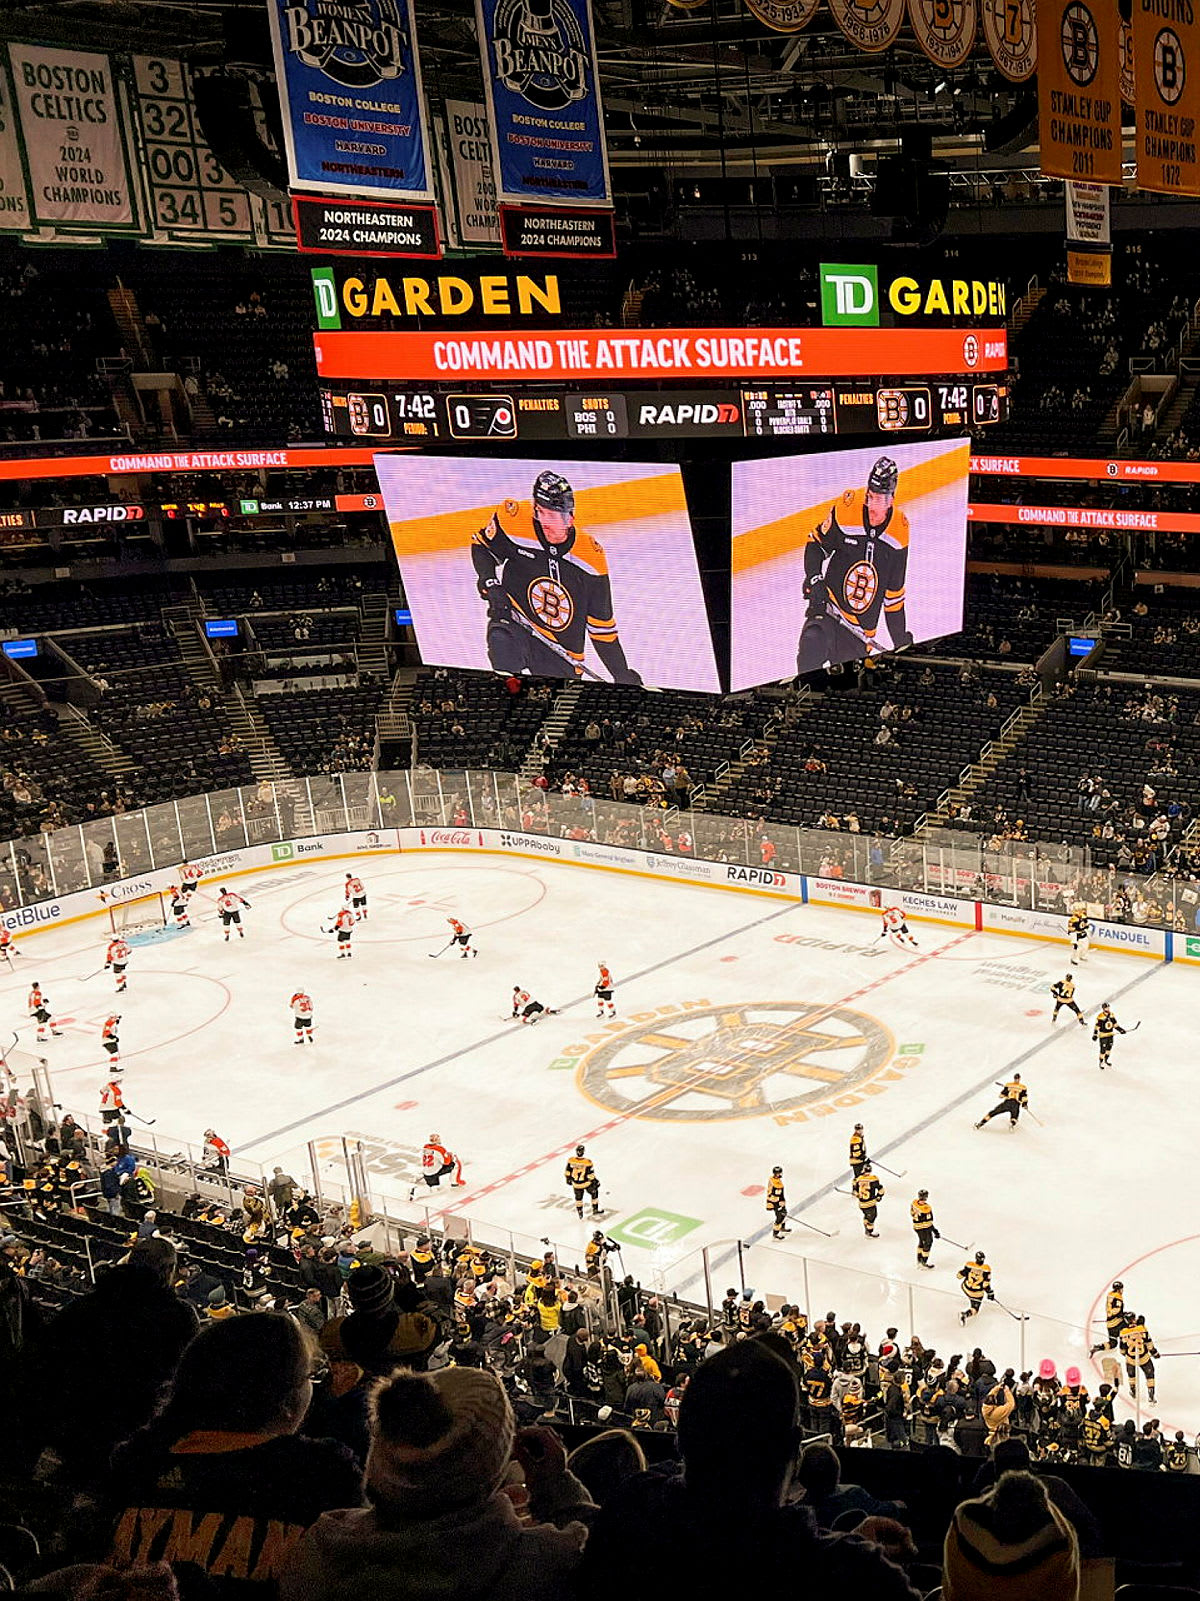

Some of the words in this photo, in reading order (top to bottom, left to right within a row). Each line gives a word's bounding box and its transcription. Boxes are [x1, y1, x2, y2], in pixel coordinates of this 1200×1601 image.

[284, 6, 408, 70] BEANPOT
[492, 37, 590, 92] BEANPOT
[22, 62, 106, 94] BOSTON
[148, 61, 169, 93] 3
[31, 93, 107, 123] CELTICS
[308, 91, 352, 108] BOSTON
[354, 99, 401, 114] COLLEGE
[1051, 90, 1091, 119] STANLEY
[1094, 102, 1112, 122] CUP
[145, 103, 187, 137] 32
[304, 112, 349, 130] BOSTON
[350, 119, 412, 136] UNIVERSITY
[454, 114, 488, 137] BOST
[512, 113, 547, 130] BOSTON
[549, 119, 587, 131] COLLEGE
[1145, 110, 1178, 135] STANLEY
[507, 132, 545, 148] BOSTON
[1050, 119, 1113, 151] CHAMPIONS
[60, 146, 91, 163] 2024
[335, 139, 387, 156] HARVARD
[459, 140, 488, 162] CELT
[1145, 135, 1196, 163] CHAMPIONS
[152, 149, 193, 182] 00
[321, 161, 405, 179] NORTHEASTERN
[532, 156, 575, 171] HARVARD
[1072, 151, 1094, 174] 2011
[56, 166, 104, 184] WORLD
[1161, 163, 1181, 186] 1972
[44, 186, 121, 206] CHAMPIONS
[159, 193, 199, 224] 34
[219, 197, 237, 226] 5
[324, 210, 413, 228] NORTHEASTERN
[466, 214, 500, 228] CHAMPI
[524, 217, 596, 231] NORTHEASTERN
[319, 228, 350, 242] 2024
[353, 230, 422, 246] CHAMPIONS
[520, 233, 545, 246] 2024
[547, 234, 602, 247] CHAMPIONS
[342, 274, 562, 318] GARDEN
[825, 274, 874, 315] TD
[888, 275, 1006, 316] GARDEN
[434, 339, 553, 371] COMMAND
[557, 340, 591, 369] THE
[596, 338, 691, 369] ATTACK
[695, 337, 803, 368] SURFACE
[395, 394, 437, 418] 7:42
[518, 398, 560, 411] PENALTIES
[582, 397, 610, 410] SHOTS
[839, 392, 874, 405] PENALTIES
[938, 386, 967, 410] 7:42
[373, 403, 385, 427] 0
[455, 404, 471, 429] 0
[574, 412, 597, 423] BOS
[606, 411, 615, 423] 0
[639, 403, 740, 425] RAPID7
[914, 397, 926, 420] 0
[577, 423, 597, 435] PHI
[607, 422, 616, 435] 0
[110, 455, 172, 471] COMMAND
[174, 455, 190, 469] THE
[191, 453, 236, 468] ATTACK
[237, 452, 288, 466] SURFACE
[980, 459, 1020, 473] SURFACE
[260, 502, 283, 511] Bank
[288, 500, 314, 510] 12:37
[315, 499, 331, 509] PM
[63, 505, 144, 525] RAPID7
[1018, 508, 1065, 523] COMMAND
[1067, 511, 1079, 523] THE
[1080, 512, 1114, 526] ATTACK
[1116, 513, 1158, 528] SURFACE
[298, 842, 323, 853] Bank
[727, 866, 786, 887] RAPID7
[816, 882, 840, 892] BOSTON
[902, 895, 936, 908] KECHES
[938, 900, 958, 911] LAW
[1098, 927, 1150, 945] FANDUEL
